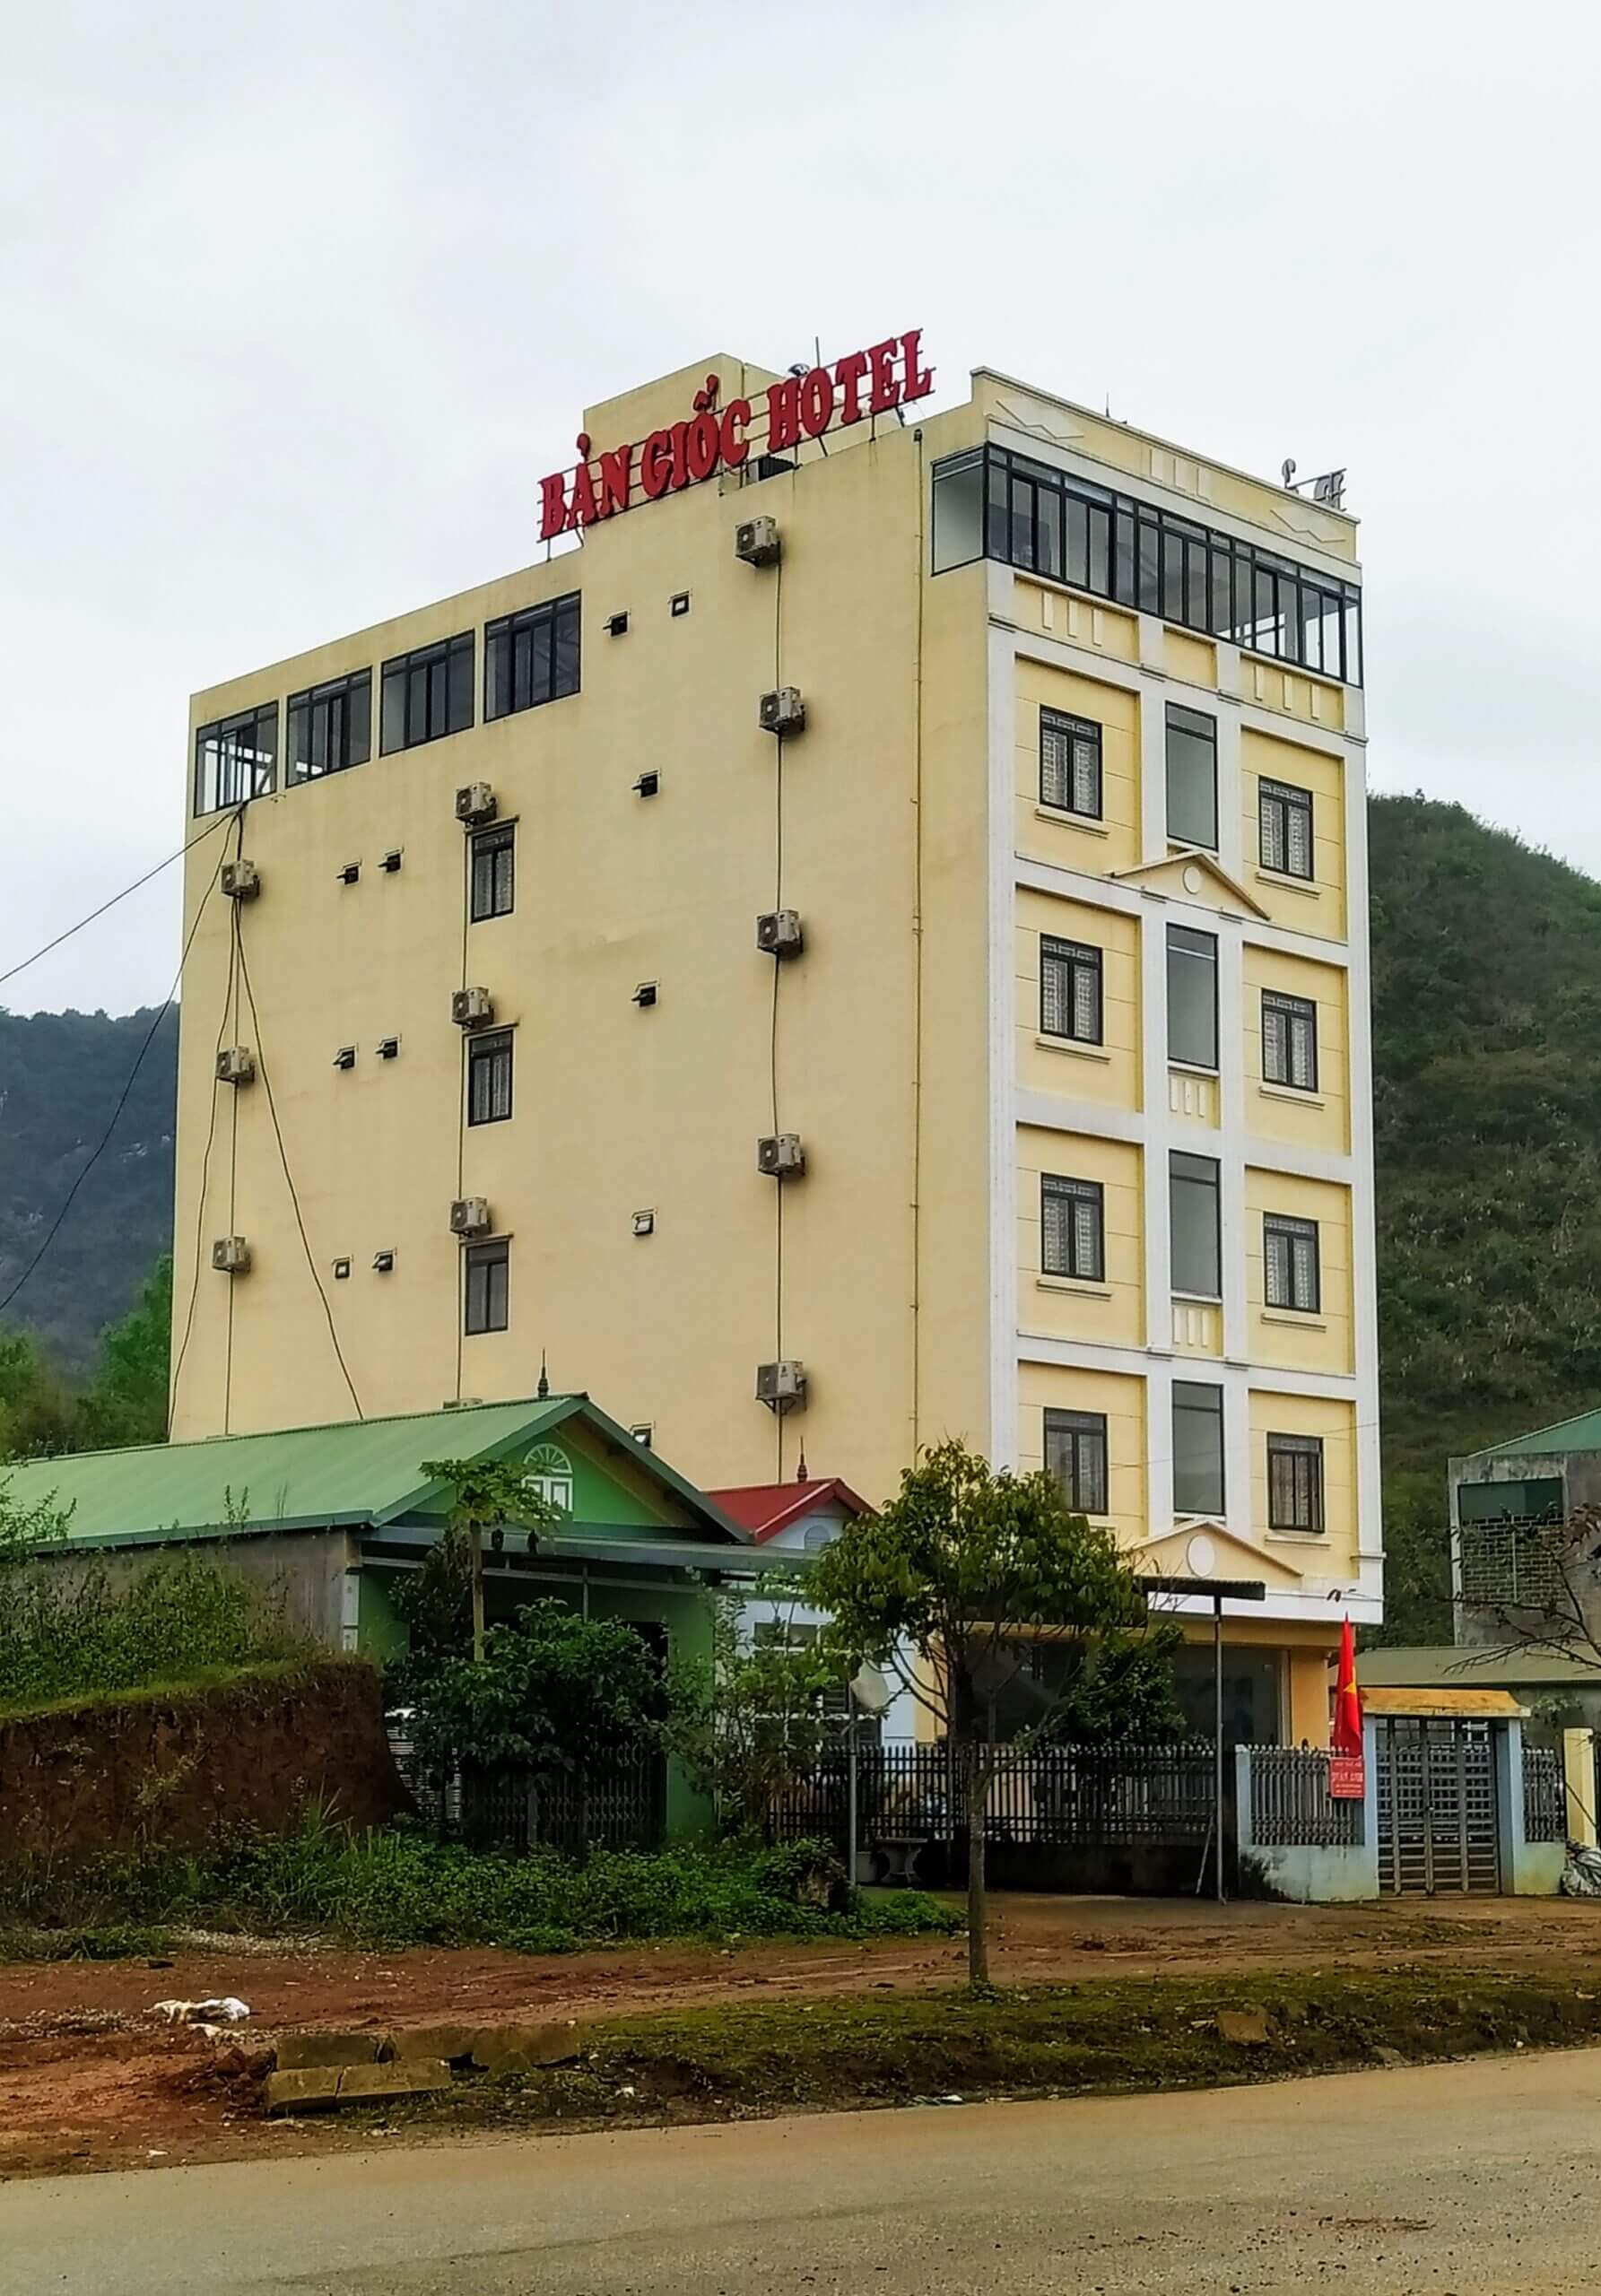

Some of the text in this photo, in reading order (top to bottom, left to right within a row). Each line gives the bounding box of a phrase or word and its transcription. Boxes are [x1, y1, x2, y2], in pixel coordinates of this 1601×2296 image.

[540, 330, 932, 539] BẢN GIỐC HOTEL
